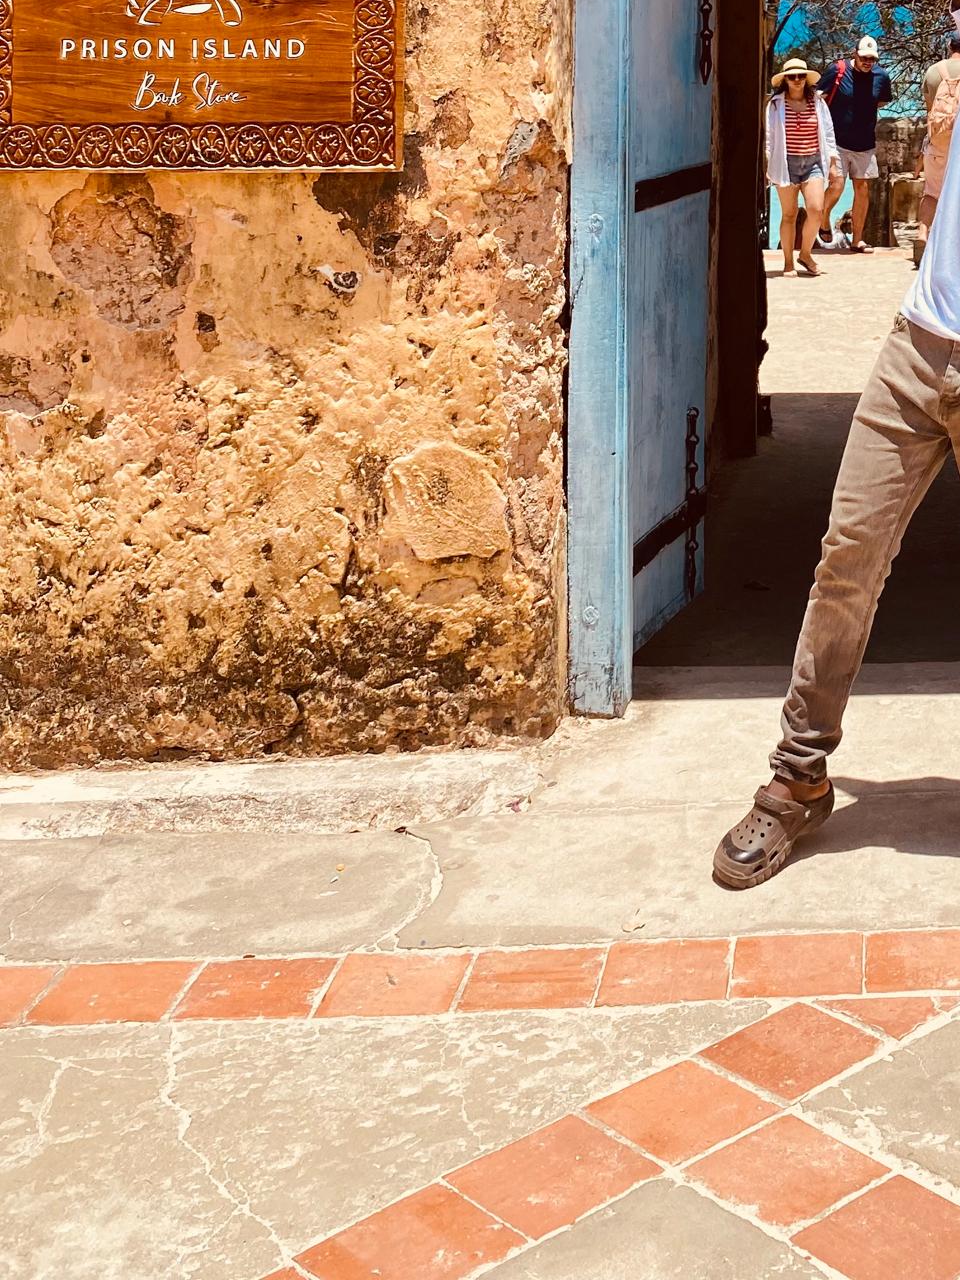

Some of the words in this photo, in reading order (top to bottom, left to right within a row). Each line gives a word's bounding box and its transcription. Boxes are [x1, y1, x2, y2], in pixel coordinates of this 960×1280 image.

[60, 38, 176, 59] PRISON
[191, 38, 307, 59] ISLAND
[131, 70, 183, 111] Book
[191, 71, 247, 111] Store
